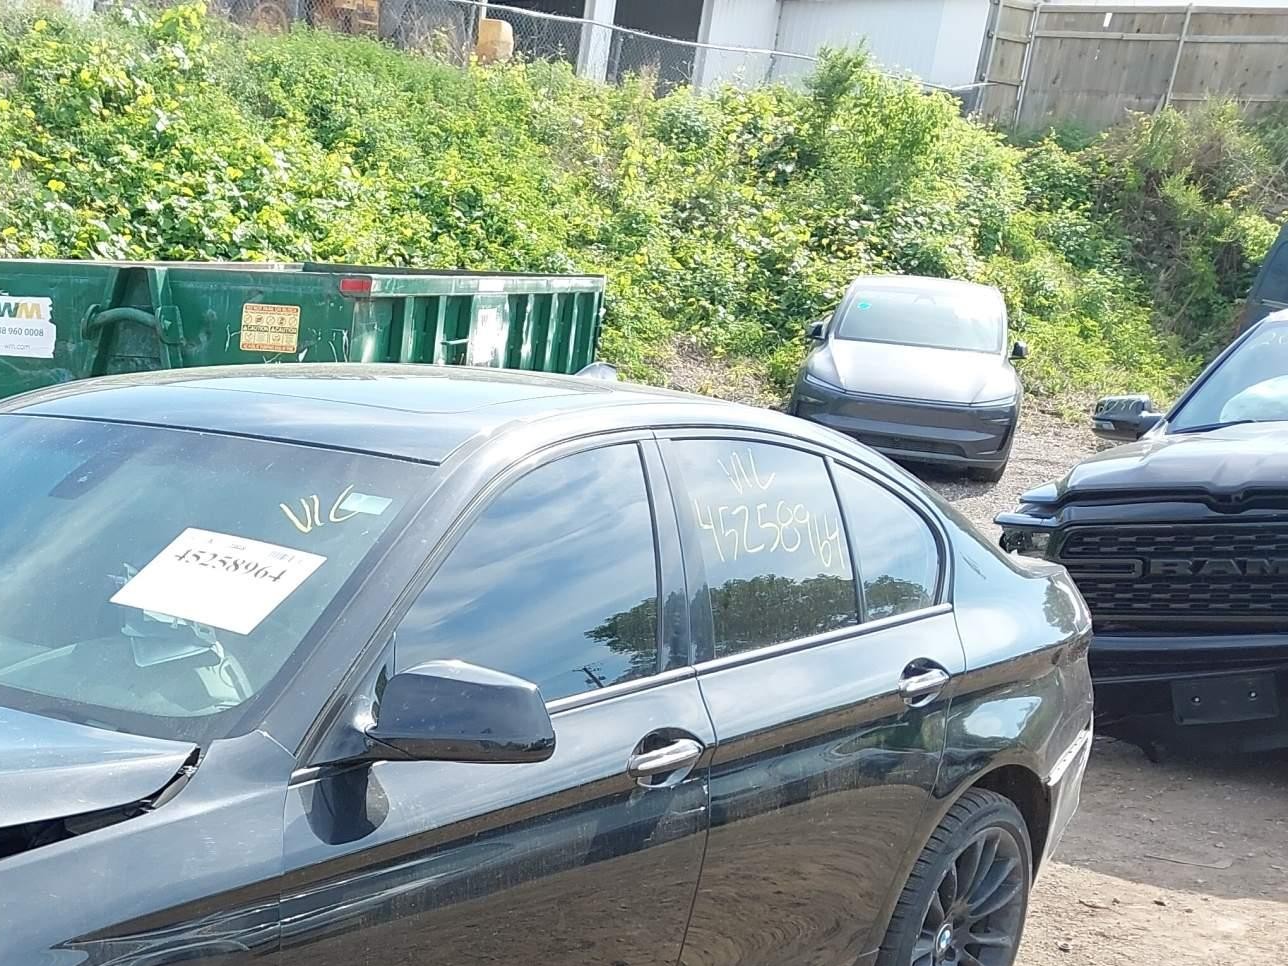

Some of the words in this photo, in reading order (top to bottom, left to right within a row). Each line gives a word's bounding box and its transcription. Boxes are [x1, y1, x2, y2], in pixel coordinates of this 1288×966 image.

[8, 327, 23, 336] 960
[24, 328, 44, 337] 0008
[694, 499, 845, 570] 45258964
[174, 548, 288, 583] 45258964
